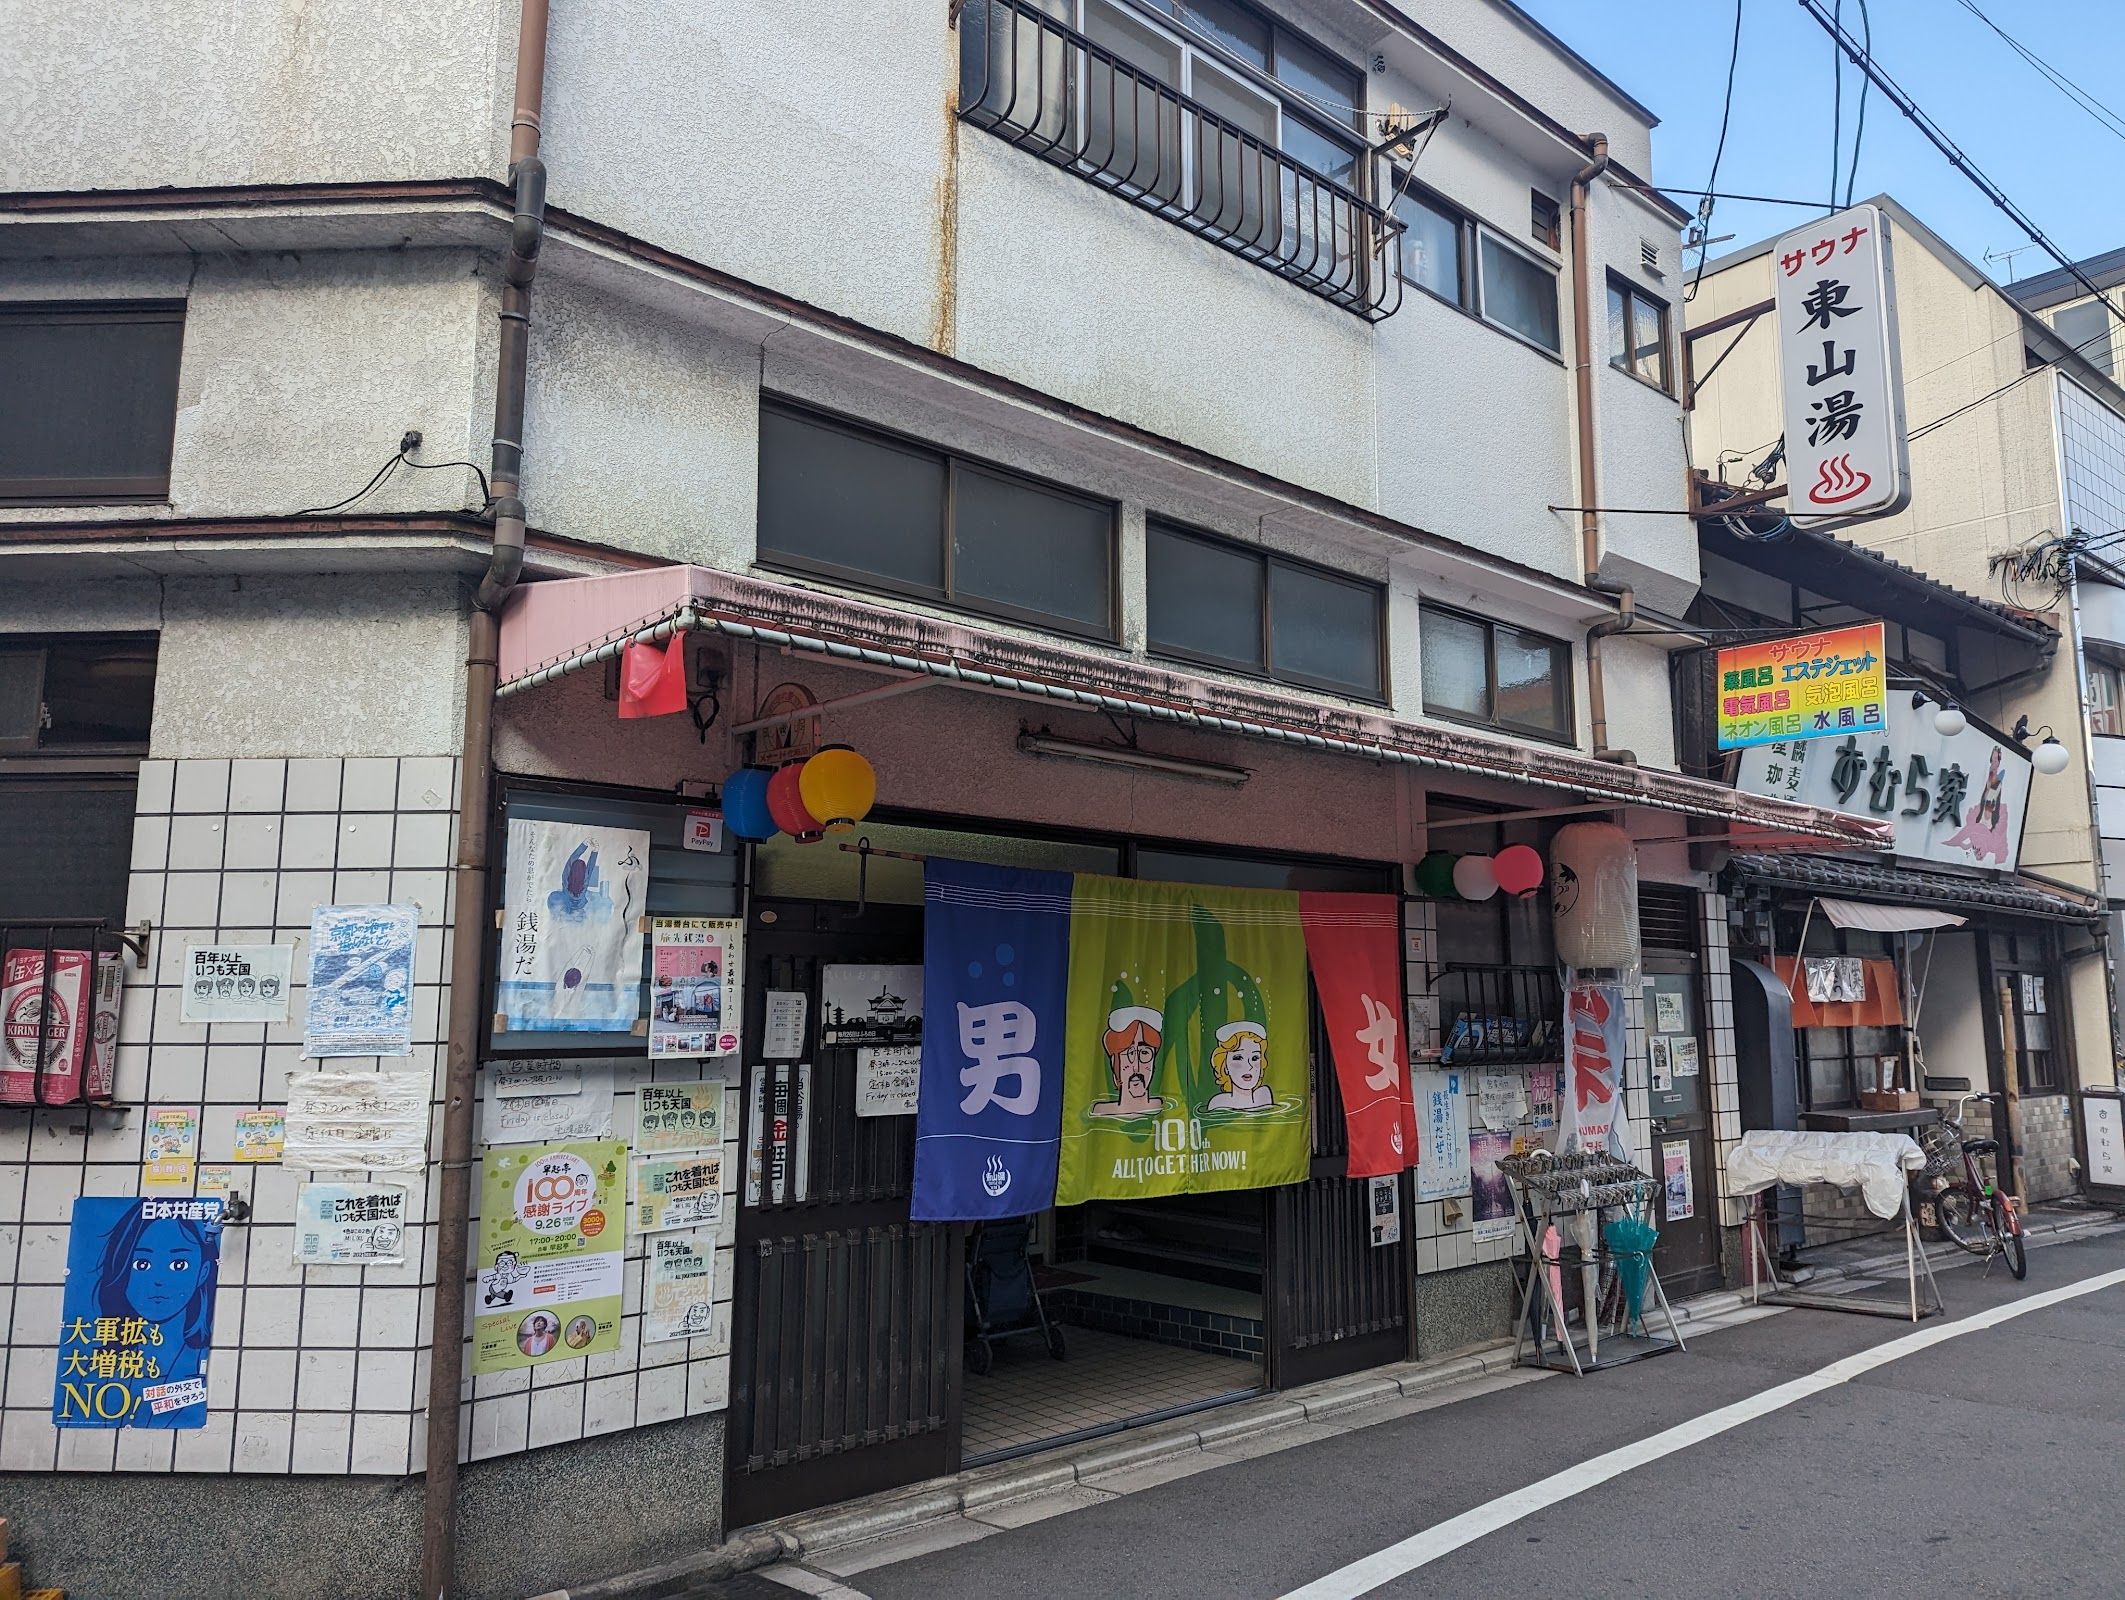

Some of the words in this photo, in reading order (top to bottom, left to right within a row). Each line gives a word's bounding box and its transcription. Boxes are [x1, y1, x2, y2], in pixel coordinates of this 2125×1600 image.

[1780, 226, 1868, 277] サウナ
[1795, 279, 1864, 448] 東山湯
[1769, 637, 1832, 659] サウナ
[1781, 650, 1877, 683] エステジェット
[1723, 666, 1774, 692] 薬風呂
[1804, 676, 1880, 707] 気泡風呂
[1723, 689, 1791, 717] 電気風呂
[1723, 714, 1802, 740] ネオン風呂
[1812, 703, 1880, 731] 水風呂
[691, 838, 714, 847] PayPay
[515, 911, 539, 975] 銭湯だ
[194, 951, 242, 965] 百年以上
[195, 963, 251, 976] いつも天国
[8, 1024, 34, 1035] KIRIN
[956, 1000, 1042, 1117] 男
[642, 1088, 684, 1101] 百年以上
[643, 1097, 692, 1112] いつも天国
[1535, 1087, 1551, 1102] NO!
[1533, 1103, 1554, 1116] 消費税
[501, 1113, 528, 1128] Friday
[542, 1163, 571, 1175] 早起亭
[665, 1162, 721, 1183] これを着れば
[1112, 1158, 1136, 1179] ALL
[1136, 1153, 1210, 1183] TOGETHER
[1211, 1150, 1247, 1171] NOW!
[527, 1175, 575, 1203] 100
[665, 1175, 719, 1194] いつも天国だぜ。
[142, 1201, 220, 1220] 日本共産党
[335, 1193, 402, 1212] これを着れば
[523, 1199, 588, 1219] 感謝ライブ
[335, 1208, 400, 1222] いつも天国だぜ。
[535, 1218, 562, 1230] 9.26
[549, 1243, 569, 1251] 早起亭
[656, 1240, 685, 1250] 百年以上
[64, 1317, 164, 1347] 大軍拡も
[481, 1316, 511, 1331] Special
[500, 1323, 517, 1333] Live
[60, 1349, 161, 1379] 大増税も
[145, 1380, 202, 1400] 対話の外交で
[57, 1382, 142, 1420] NO!
[153, 1391, 207, 1412] 平和を守ろう
